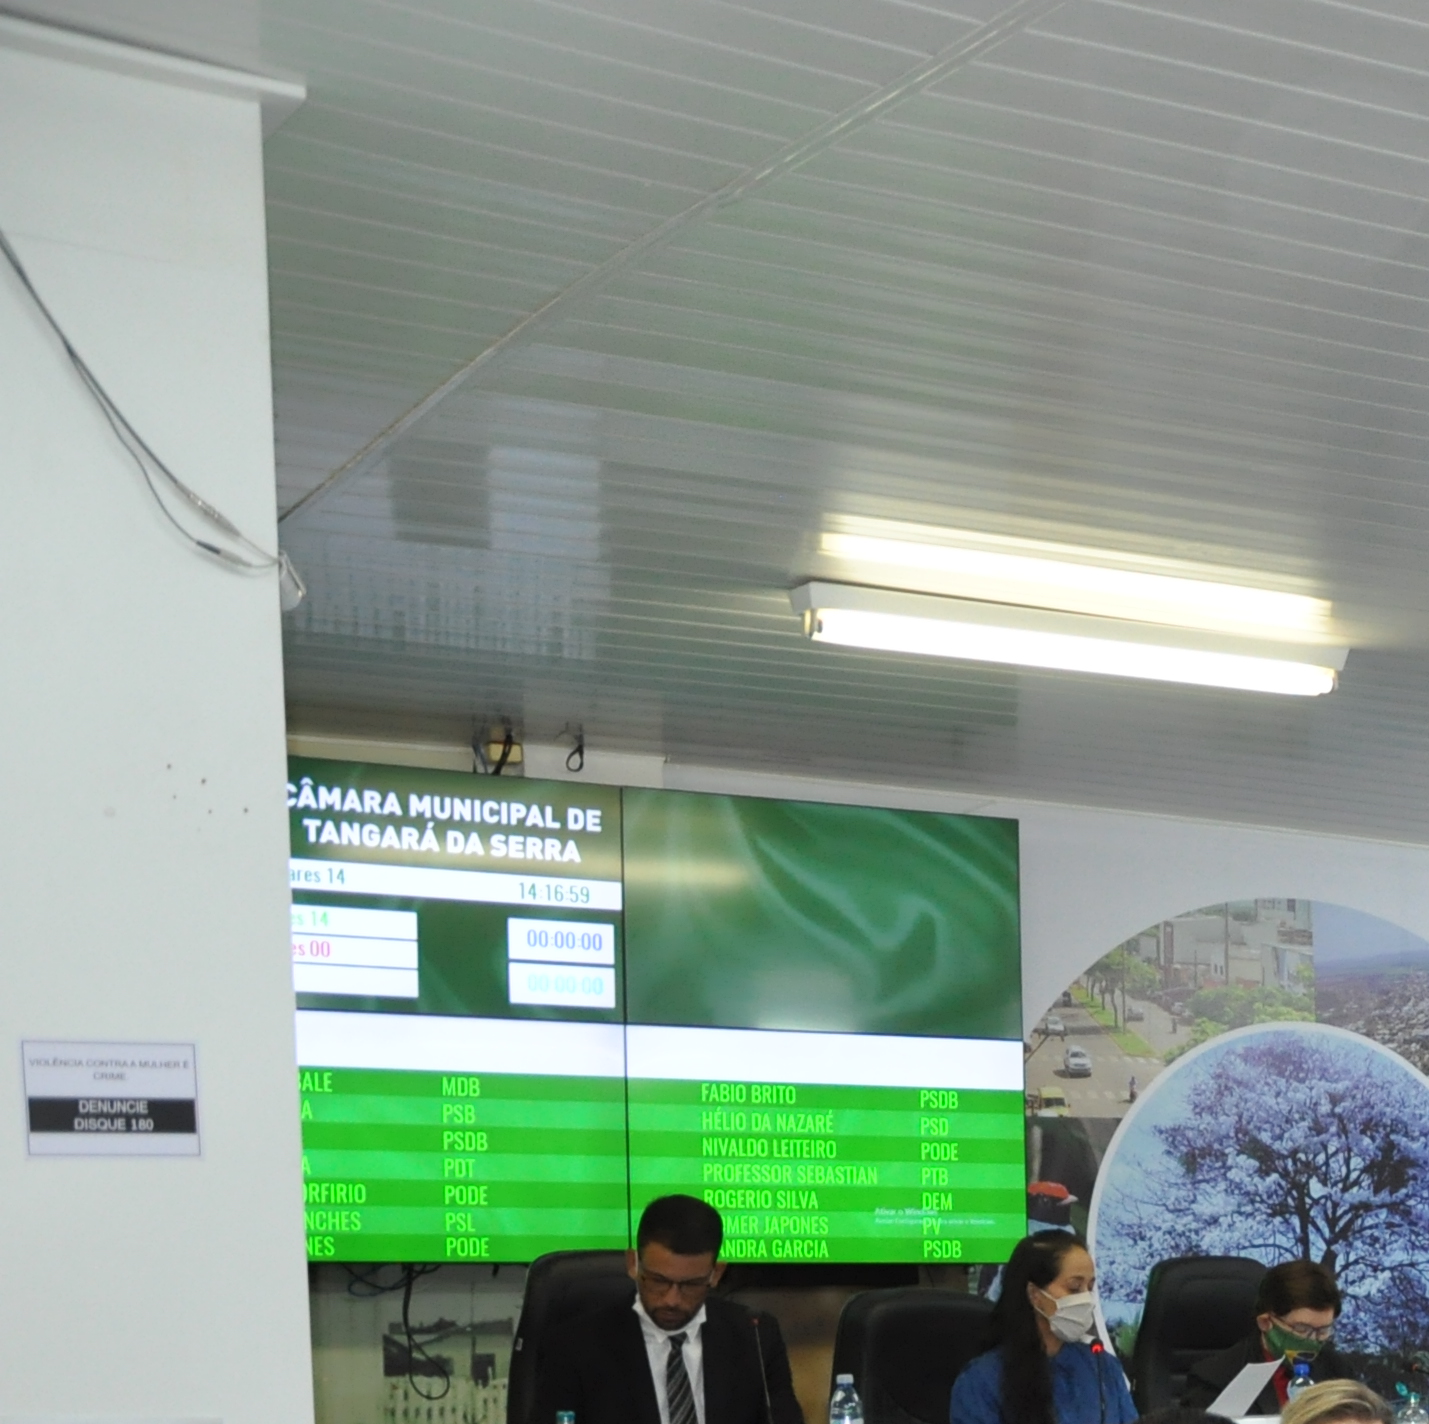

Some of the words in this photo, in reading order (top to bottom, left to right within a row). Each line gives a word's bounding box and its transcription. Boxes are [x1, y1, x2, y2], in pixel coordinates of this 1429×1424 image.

[285, 777, 402, 815] CÂMARA
[409, 793, 561, 829] MUNICIPAL
[567, 807, 602, 832] DE
[303, 818, 440, 853] TANGARÁ
[446, 830, 485, 856] DA
[490, 835, 581, 863] SERRA
[327, 867, 345, 884] 14
[519, 882, 590, 904] 14:16:59
[311, 910, 329, 927] 14
[310, 941, 331, 957] 00
[527, 929, 603, 951] 00:00:00
[28, 1057, 83, 1067] VIOLÊNCIA
[86, 1060, 128, 1068] CONTRA
[138, 1060, 180, 1069] MULHER
[93, 1072, 126, 1081] CRIME
[442, 1076, 480, 1097] MDB
[701, 1082, 746, 1103] FABIO
[751, 1084, 797, 1105] BRITO
[920, 1089, 959, 1109] PSDB
[78, 1100, 149, 1114] DENUNCIE
[443, 1104, 475, 1124] PSB
[74, 1118, 127, 1131] DISQUE
[130, 1118, 154, 1131] 180
[702, 1106, 746, 1132] HÉLIO
[751, 1113, 772, 1132] DA
[776, 1109, 834, 1133] NAZARÉ
[920, 1117, 949, 1136] PSD
[443, 1131, 488, 1151] PSDB
[702, 1137, 769, 1158] NIVALDO
[772, 1139, 837, 1159] LEITEIRO
[920, 1142, 959, 1161] PODE
[444, 1158, 475, 1178] PDT
[703, 1163, 792, 1184] PROFESSOR
[796, 1165, 878, 1185] SEBASTIAN
[921, 1167, 948, 1186] PTB
[444, 1185, 488, 1206] PODE
[704, 1188, 772, 1209] ROGERIO
[776, 1190, 819, 1209] SILVA
[922, 1192, 953, 1211] DEM
[445, 1212, 475, 1232] PSL
[763, 1216, 829, 1235] JAPONES
[923, 1217, 942, 1235] PV
[446, 1237, 490, 1257] PODE
[771, 1239, 829, 1258] GARCIA
[923, 1239, 962, 1259] PSDB
